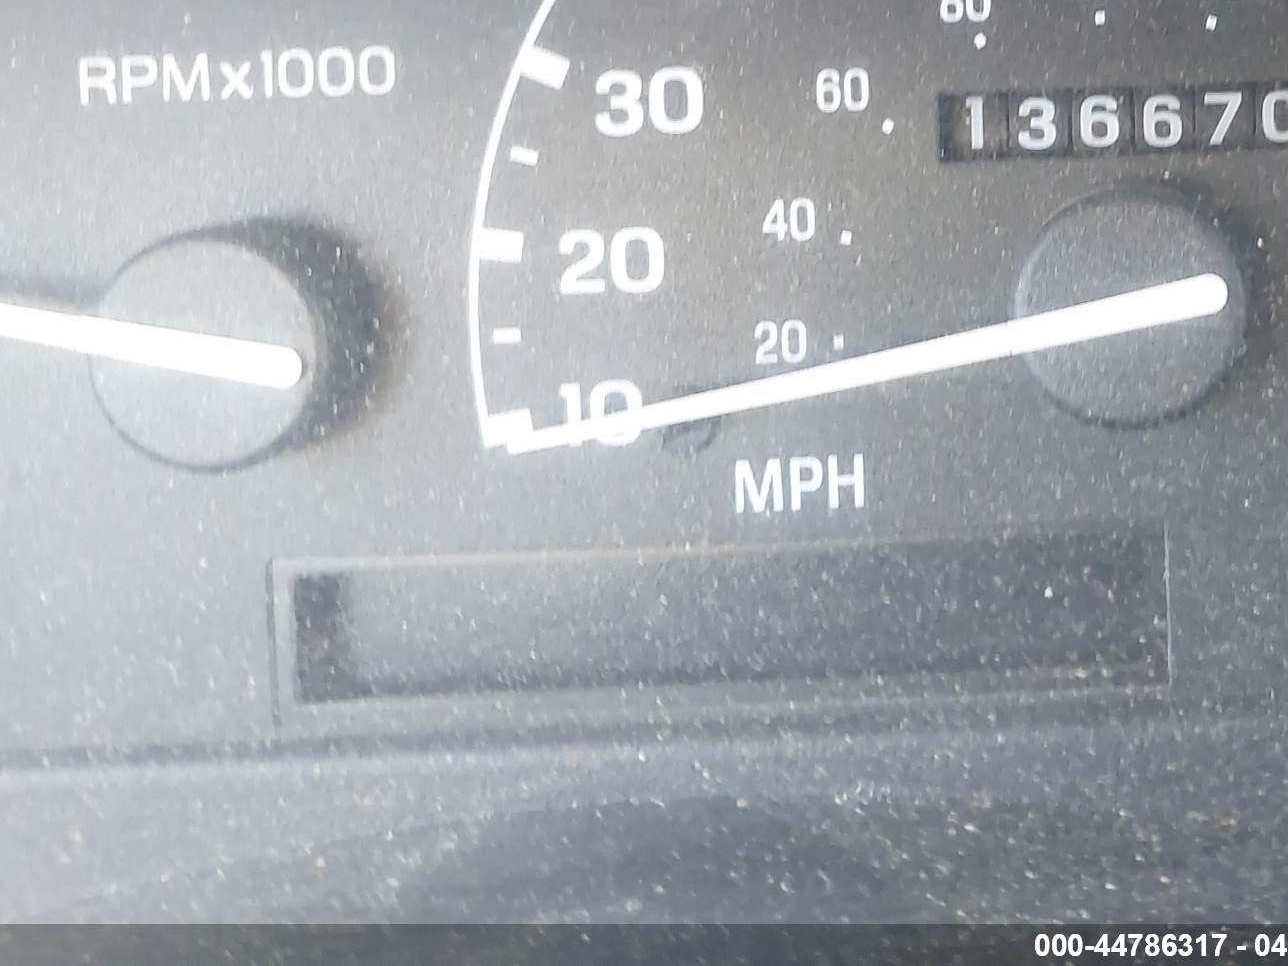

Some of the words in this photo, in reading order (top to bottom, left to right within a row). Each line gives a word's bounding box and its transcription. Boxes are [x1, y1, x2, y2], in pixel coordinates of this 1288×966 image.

[594, 67, 705, 136] 30
[815, 68, 870, 114] 60
[762, 198, 816, 243] 40
[558, 227, 665, 295] 20
[753, 320, 807, 365] 20
[557, 380, 644, 446] 10
[733, 454, 867, 514] MPH
